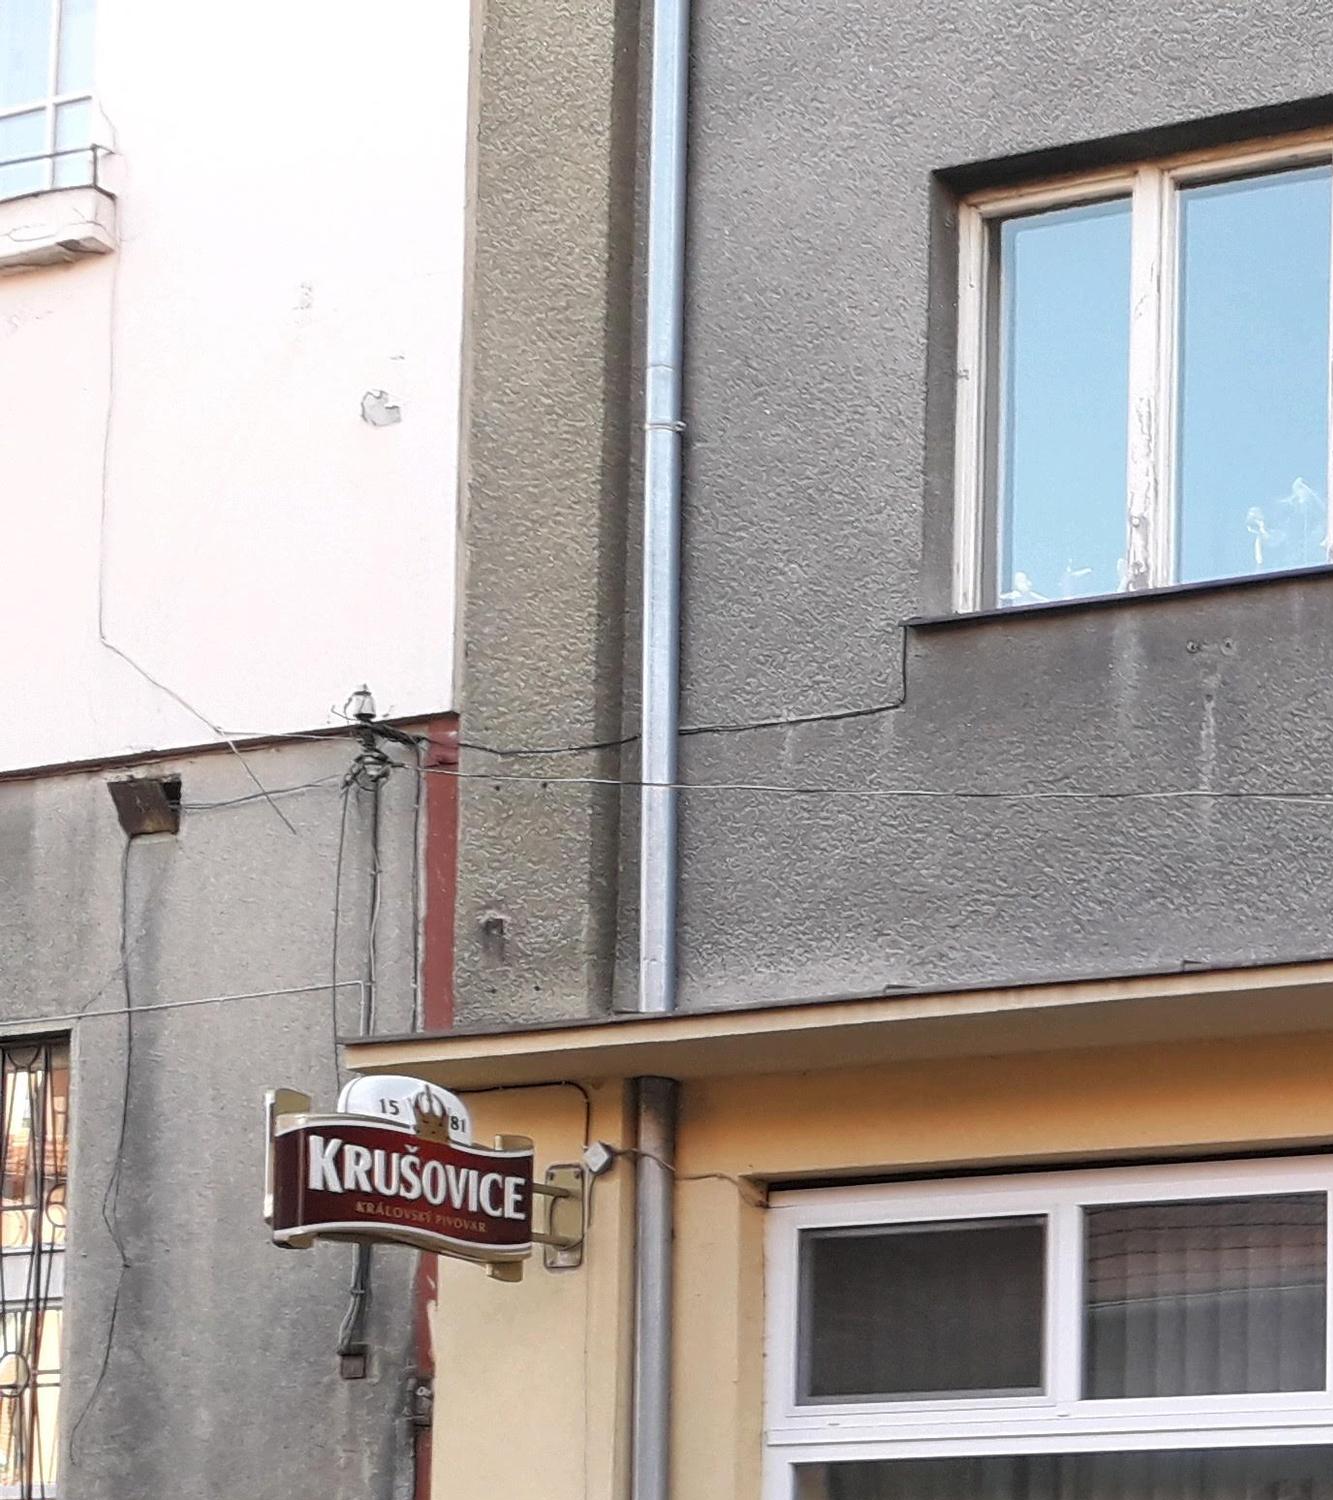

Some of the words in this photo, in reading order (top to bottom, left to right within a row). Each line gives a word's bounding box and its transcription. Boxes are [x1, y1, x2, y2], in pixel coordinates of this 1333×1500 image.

[379, 1098, 400, 1116] 15
[450, 1115, 466, 1133] 81
[307, 1134, 527, 1221] KRUŠOVICE
[435, 1215, 487, 1233] PIVOVAR
